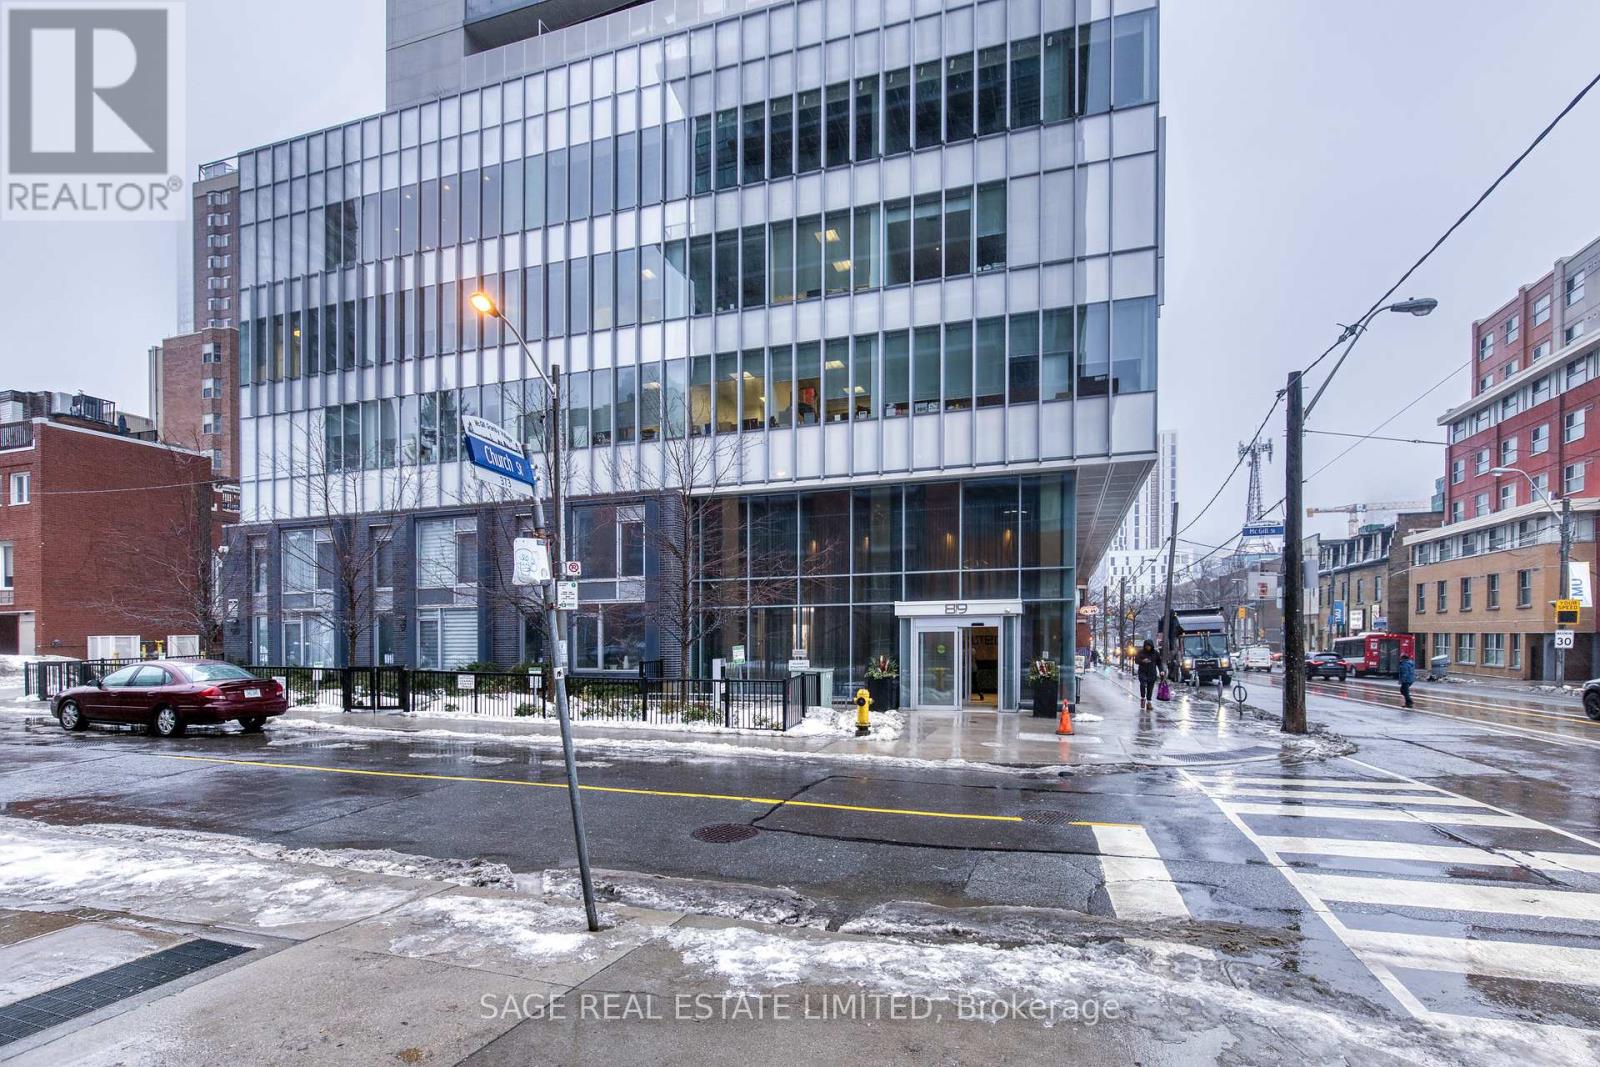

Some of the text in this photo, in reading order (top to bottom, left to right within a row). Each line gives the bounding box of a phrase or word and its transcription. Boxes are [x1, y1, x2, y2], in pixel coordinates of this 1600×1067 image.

[484, 445, 514, 472] Church
[945, 604, 968, 615] 89
[1557, 637, 1572, 646] 30
